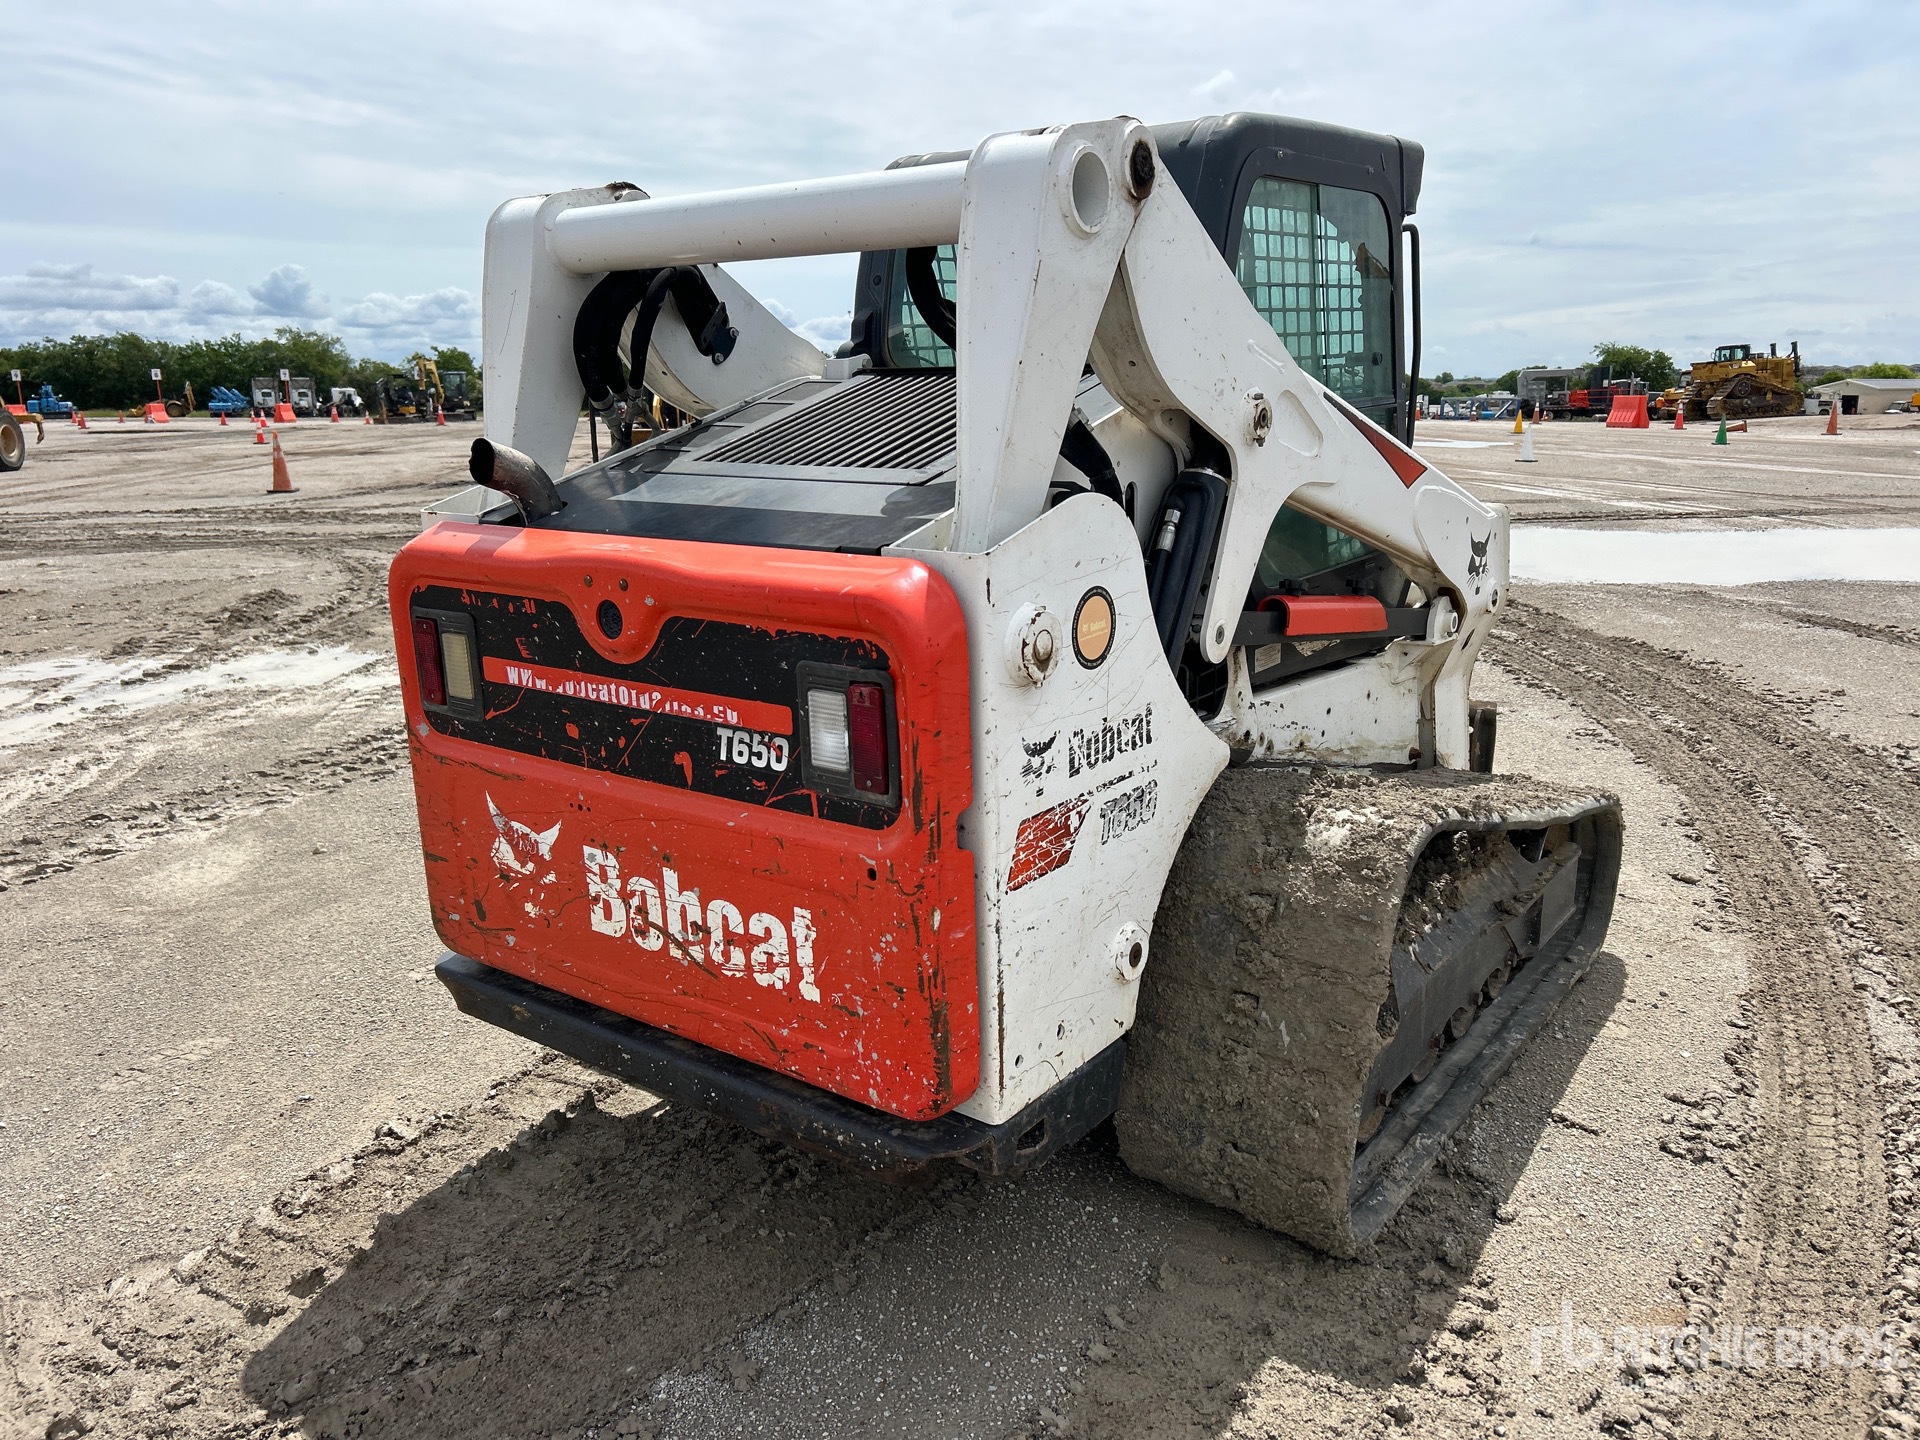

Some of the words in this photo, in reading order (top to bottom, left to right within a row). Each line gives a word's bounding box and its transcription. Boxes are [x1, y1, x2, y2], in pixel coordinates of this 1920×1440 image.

[716, 727, 790, 771] T650
[1068, 702, 1153, 778] Bobcat
[582, 845, 821, 1004] Bobcat
